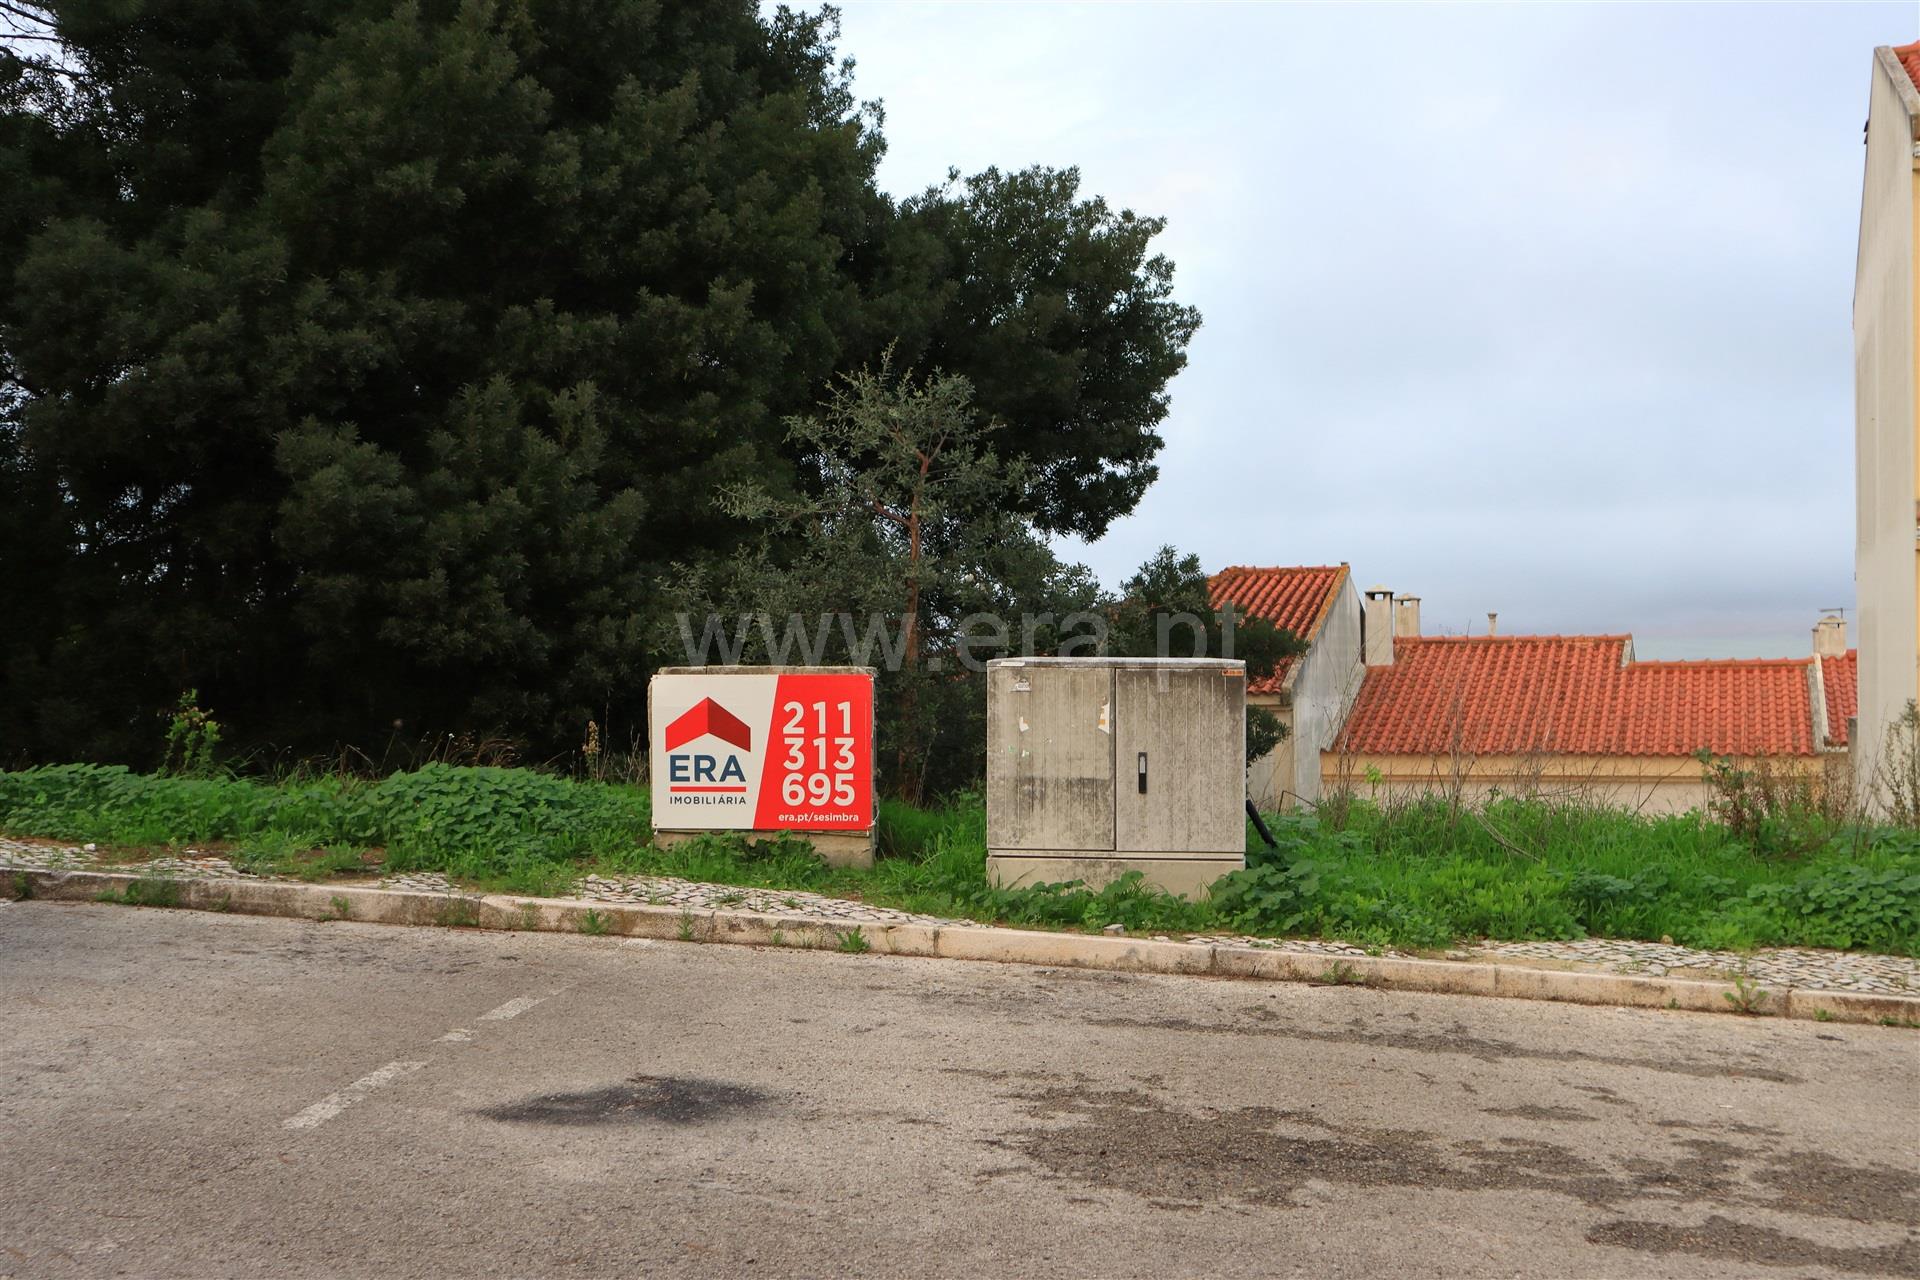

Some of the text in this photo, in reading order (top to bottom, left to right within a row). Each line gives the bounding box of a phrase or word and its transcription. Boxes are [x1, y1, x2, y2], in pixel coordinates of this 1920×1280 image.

[782, 701, 851, 735] 211
[669, 754, 747, 783] ERA
[783, 737, 855, 771] 313
[669, 794, 747, 805] IMOBILIÁRIA
[782, 773, 855, 807] 695
[778, 812, 859, 823] era.pt/sesimbra
